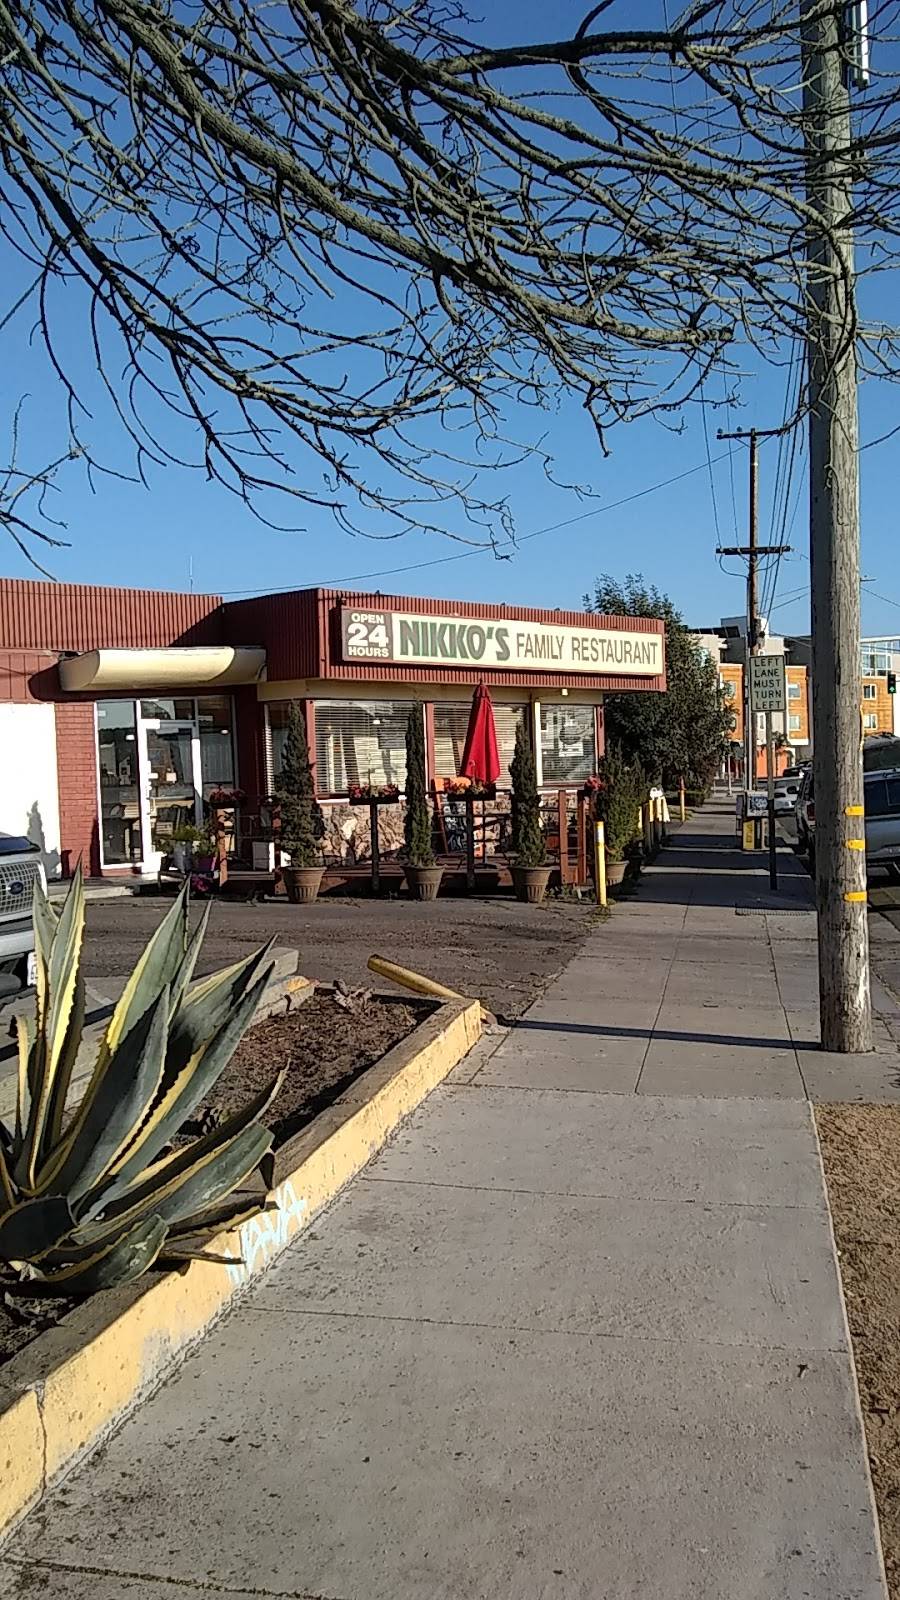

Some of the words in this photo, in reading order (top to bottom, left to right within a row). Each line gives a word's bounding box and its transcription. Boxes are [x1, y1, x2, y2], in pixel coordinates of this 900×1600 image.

[351, 612, 386, 625] OPEN
[347, 621, 389, 647] 24
[399, 619, 511, 661] NIKKO'S
[516, 632, 565, 661] FAMILY
[571, 637, 658, 665] RESTAURANT
[348, 646, 389, 659] HOURS
[754, 658, 779, 667] LEFT
[754, 668, 780, 677] LANE
[754, 679, 781, 688] MUST
[754, 690, 782, 699] TURN
[755, 701, 782, 710] LEFT
